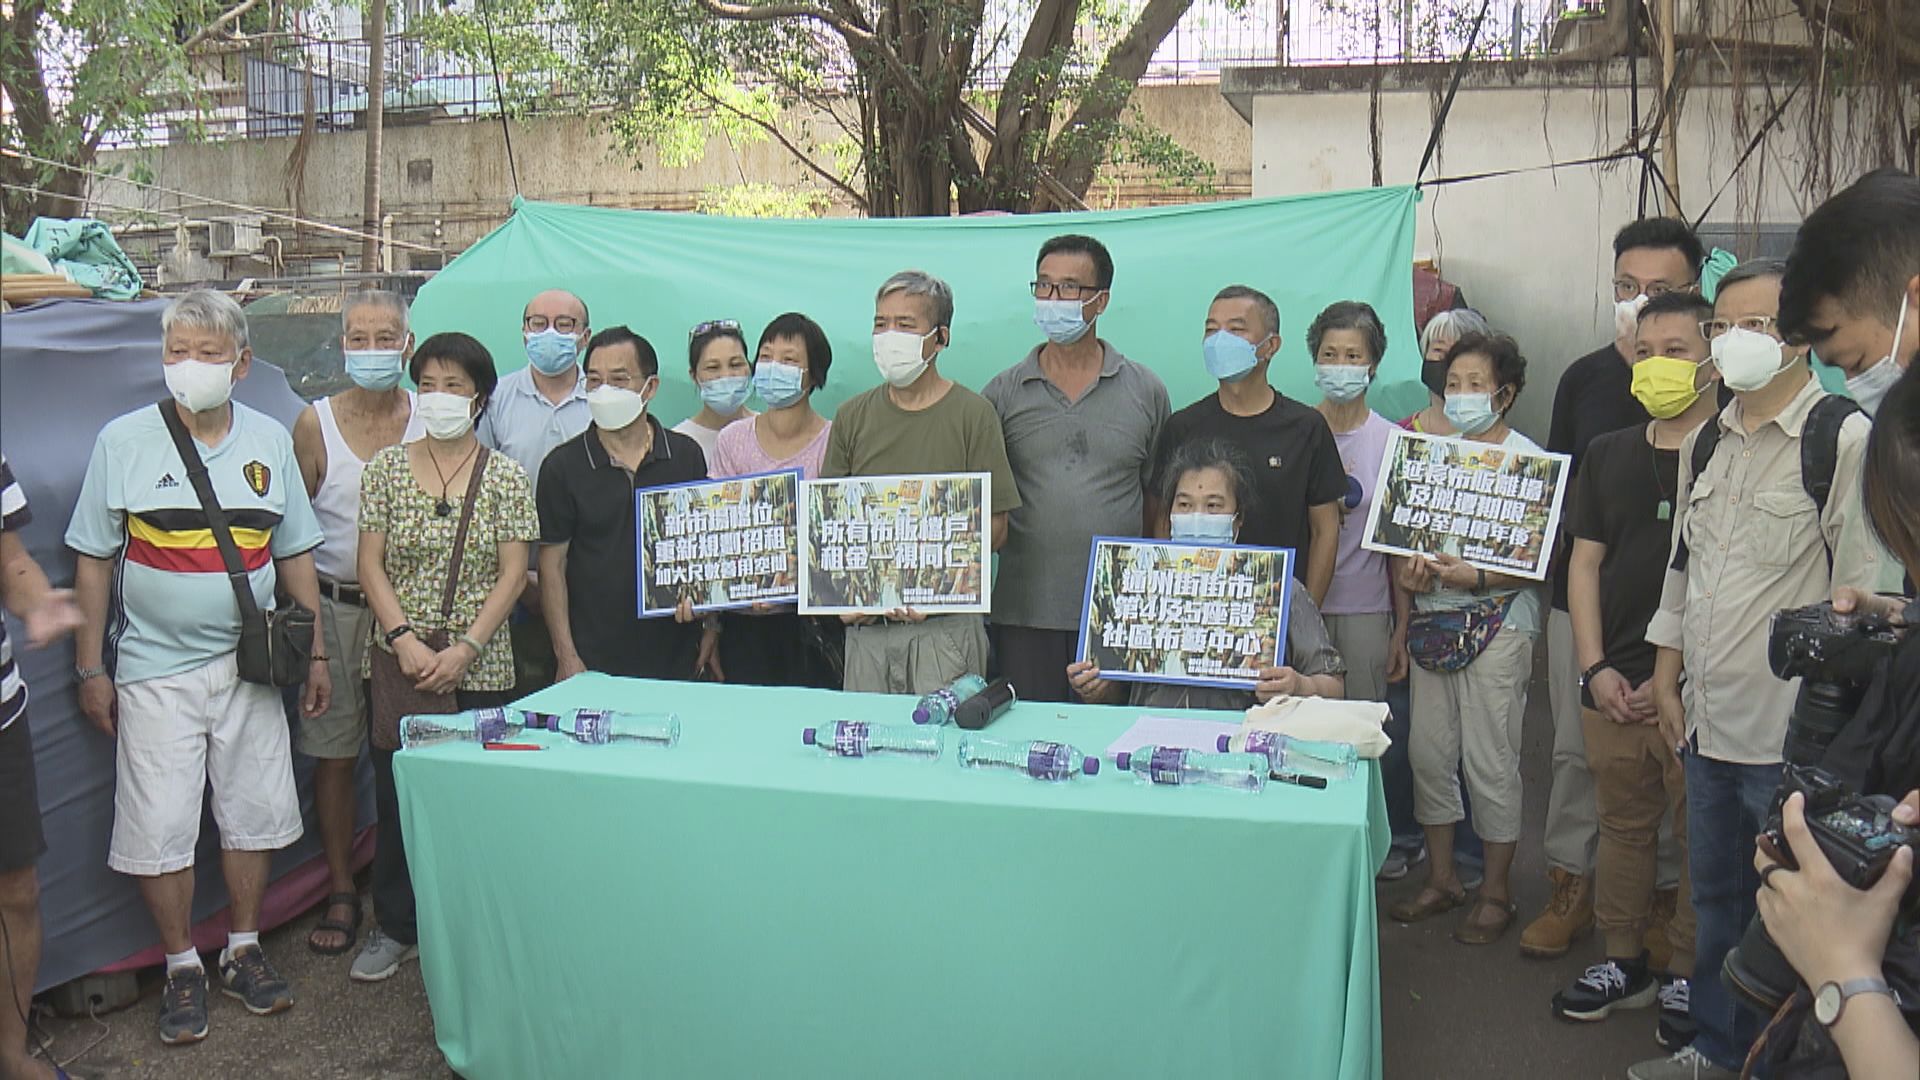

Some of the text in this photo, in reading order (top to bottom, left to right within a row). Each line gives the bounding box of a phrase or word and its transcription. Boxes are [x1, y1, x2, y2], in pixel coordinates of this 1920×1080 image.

[1407, 484, 1528, 523] 及搬遷期限
[655, 526, 787, 563] 重新規劃招租
[821, 515, 969, 543] 所有布販檔戶
[821, 542, 969, 570] 租金一視同仁
[1121, 568, 1255, 599] 通州街街市
[1114, 595, 1256, 627] 第4及5座設
[1102, 622, 1262, 655] 社區布藝中心
